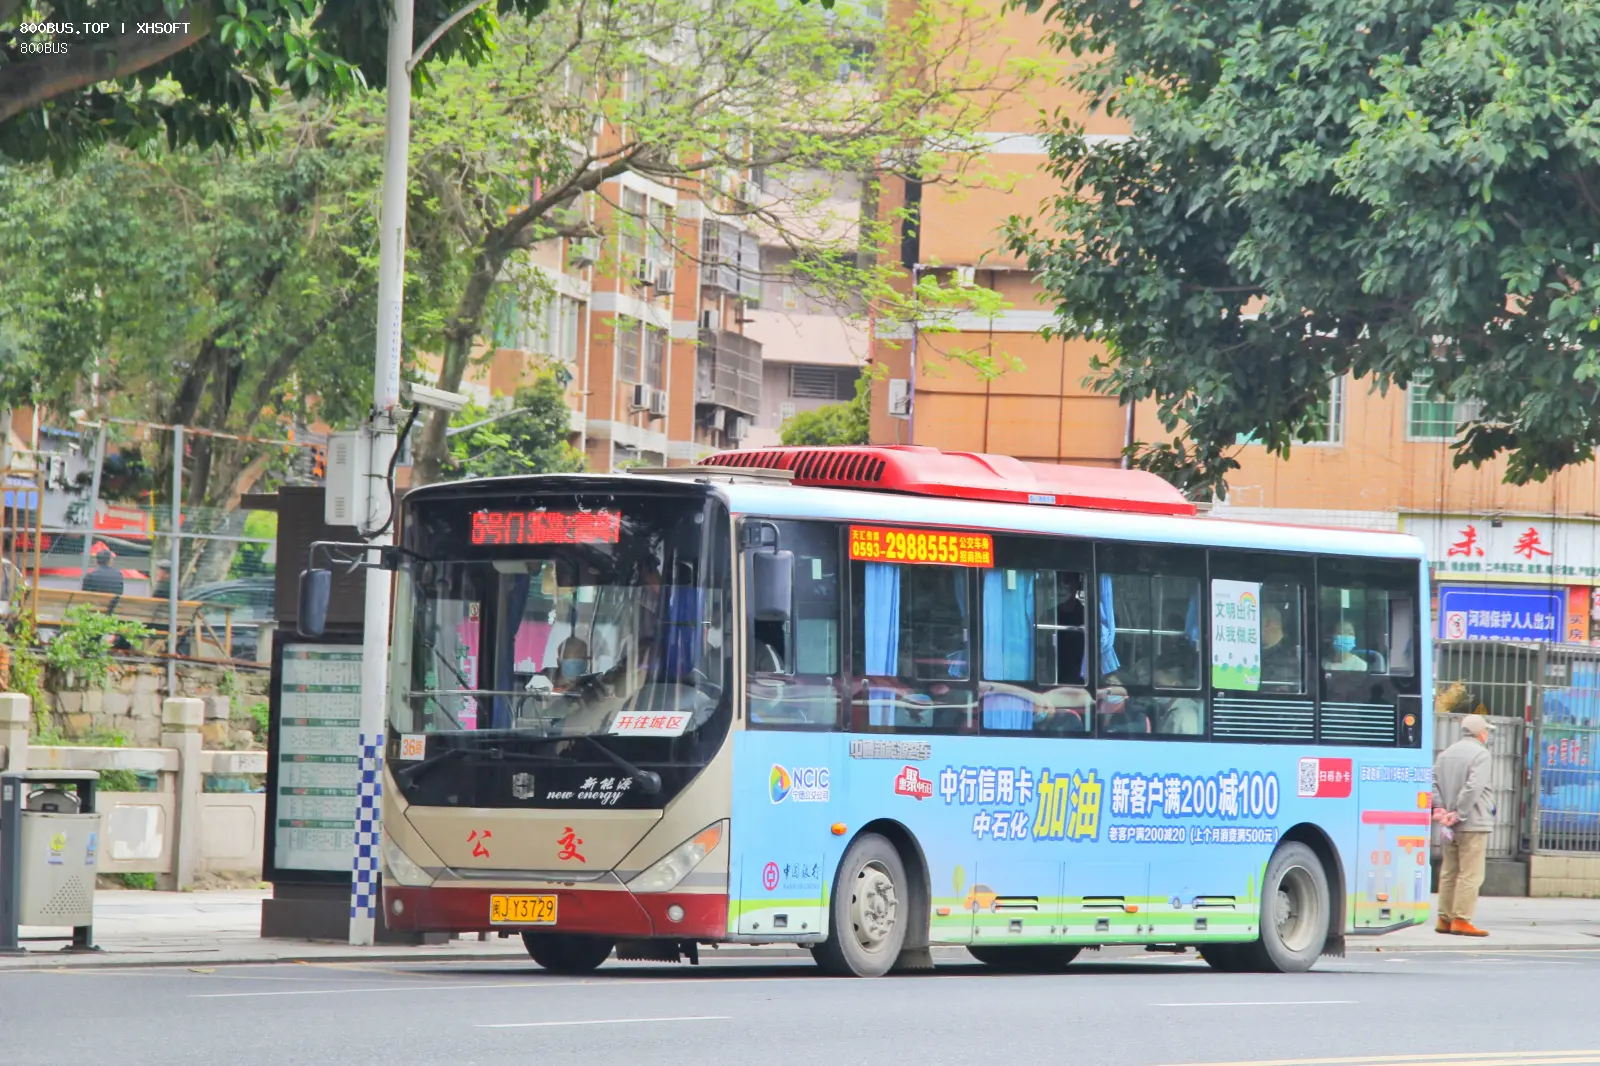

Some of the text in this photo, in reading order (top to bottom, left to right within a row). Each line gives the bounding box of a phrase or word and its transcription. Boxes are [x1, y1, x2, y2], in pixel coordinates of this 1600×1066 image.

[852, 531, 959, 562] 0593-2988555
[959, 536, 990, 550] 公交车身
[1447, 524, 1553, 560] 未来
[959, 550, 991, 564] 招商热线
[1215, 601, 1257, 621] 文明出行
[1468, 609, 1555, 630] 河湖保护人人出力
[1215, 625, 1257, 644] 从我做起
[616, 714, 685, 731] 开往城区
[580, 776, 634, 791] 新能源
[793, 768, 830, 789] NCIC
[940, 766, 1034, 804] 中行信用卡
[1318, 770, 1351, 783] 扫码办卡
[546, 790, 624, 805] new energy
[1111, 772, 1279, 818] 新客户满200减100
[1034, 770, 1102, 842] 加油
[972, 811, 1030, 840] 中石化
[1108, 826, 1186, 842] 老客户满200减20
[465, 826, 587, 863] 公交
